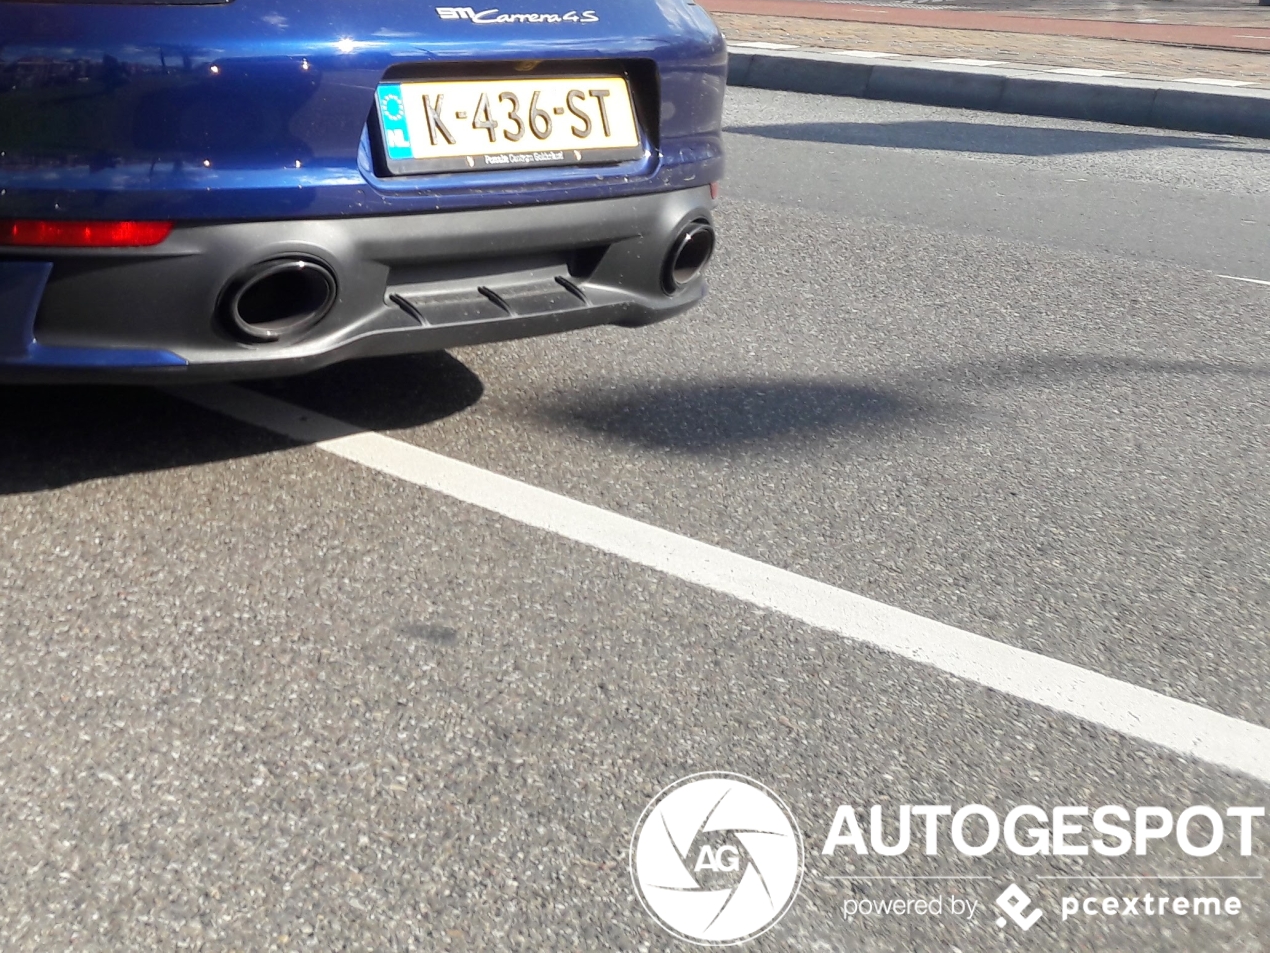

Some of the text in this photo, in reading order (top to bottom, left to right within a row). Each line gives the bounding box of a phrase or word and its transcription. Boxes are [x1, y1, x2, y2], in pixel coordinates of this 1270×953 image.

[436, 7, 475, 20] 911
[472, 9, 562, 24] Carrera
[422, 89, 611, 145] K-436-ST
[387, 129, 411, 147] NL
